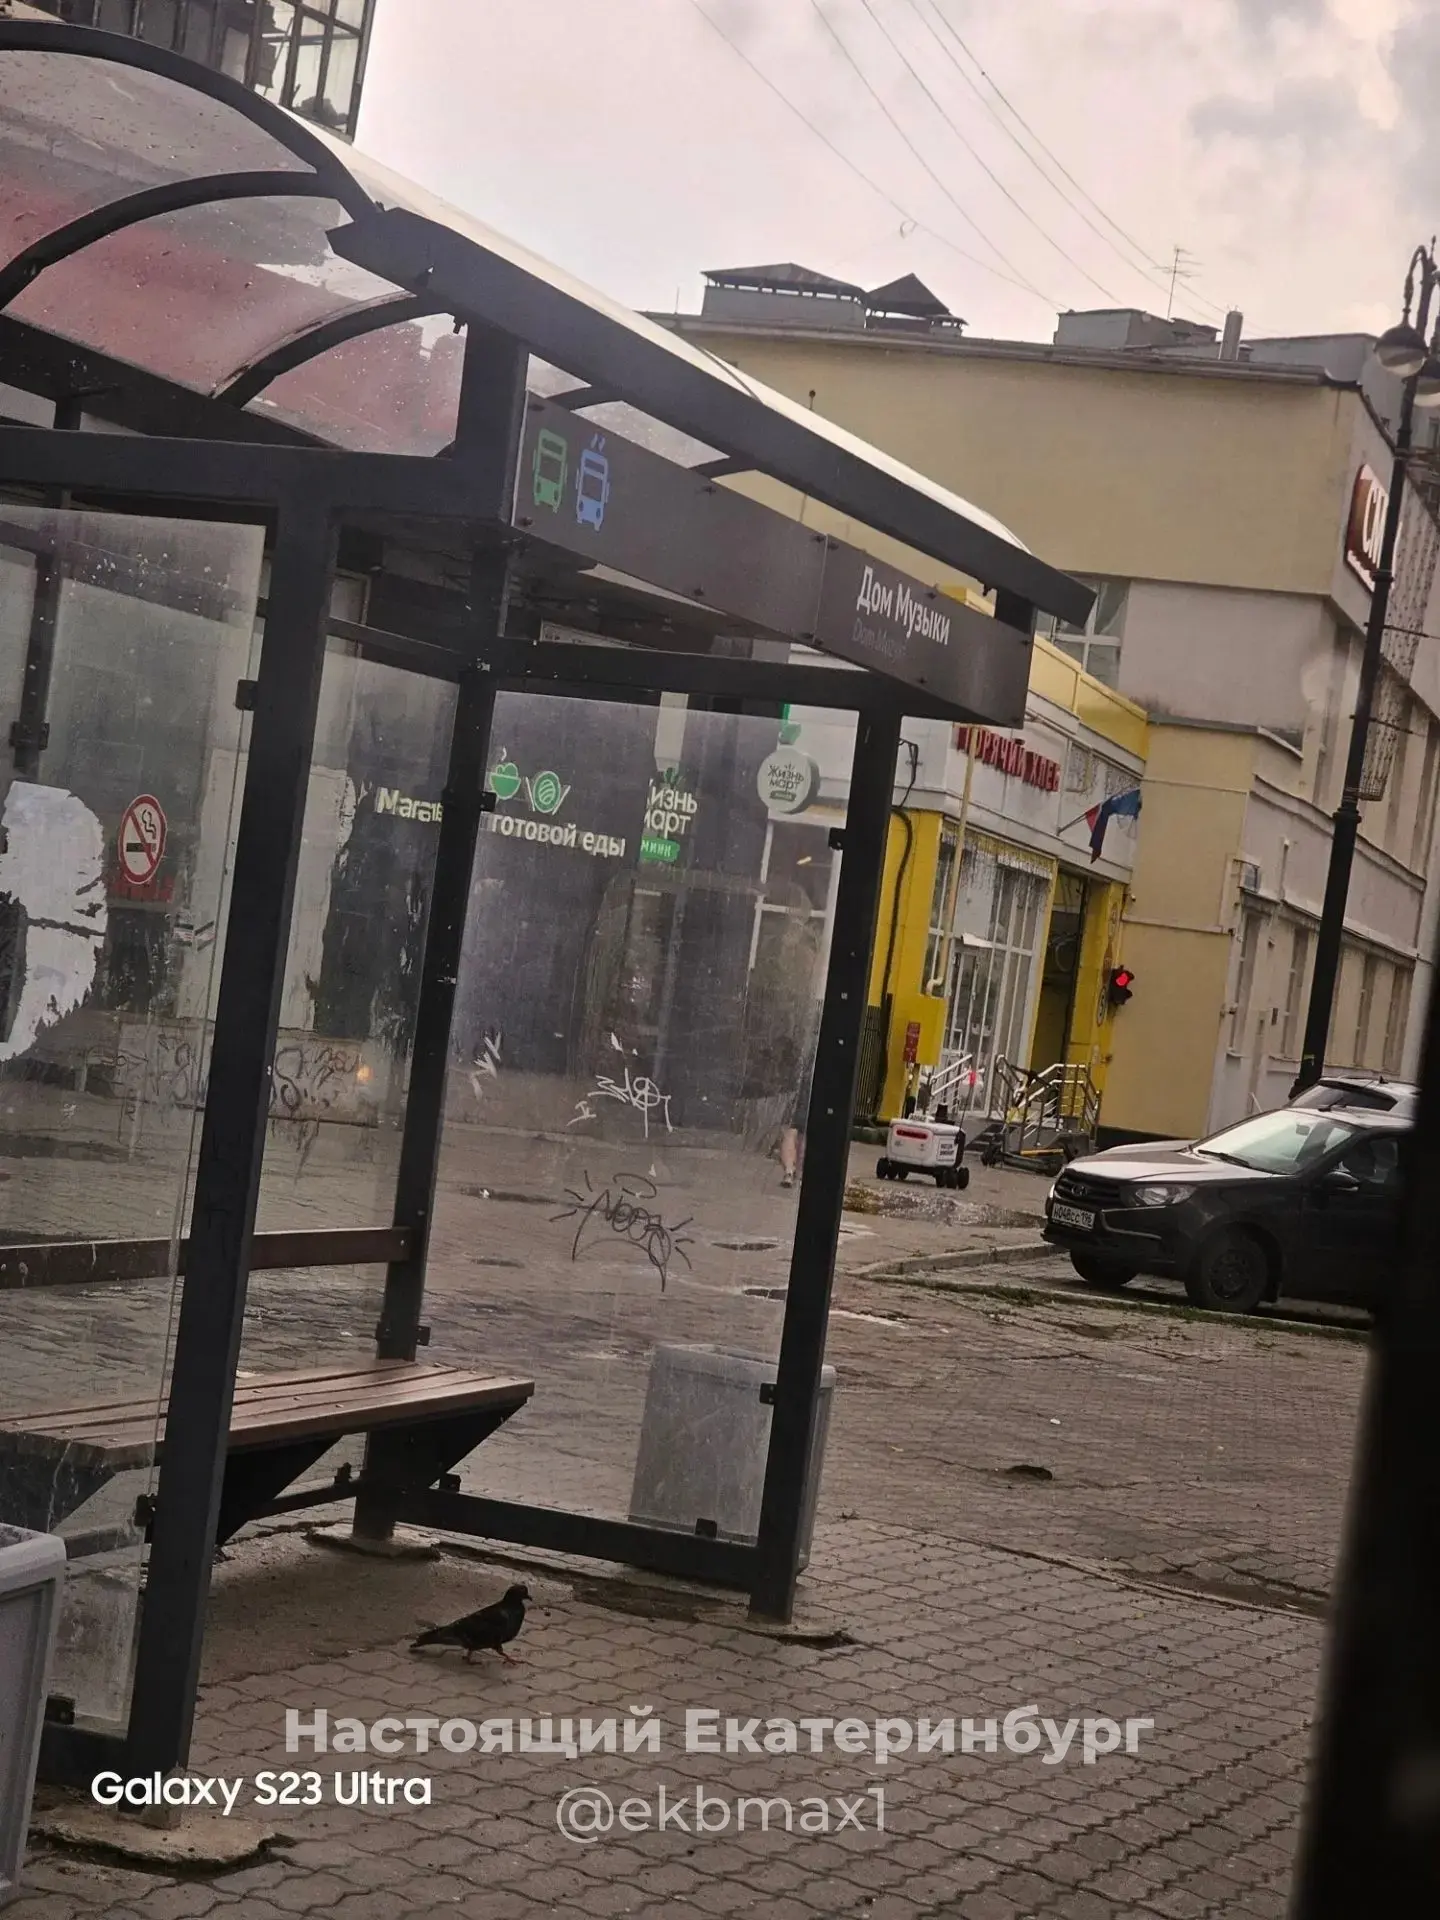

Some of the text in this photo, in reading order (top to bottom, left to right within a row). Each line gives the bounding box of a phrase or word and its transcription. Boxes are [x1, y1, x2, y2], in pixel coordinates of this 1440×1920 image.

[857, 565, 893, 619] Дом
[895, 583, 950, 646] Музыки
[646, 779, 698, 814] изнь
[491, 814, 577, 848] готовой
[582, 831, 626, 858] еды
